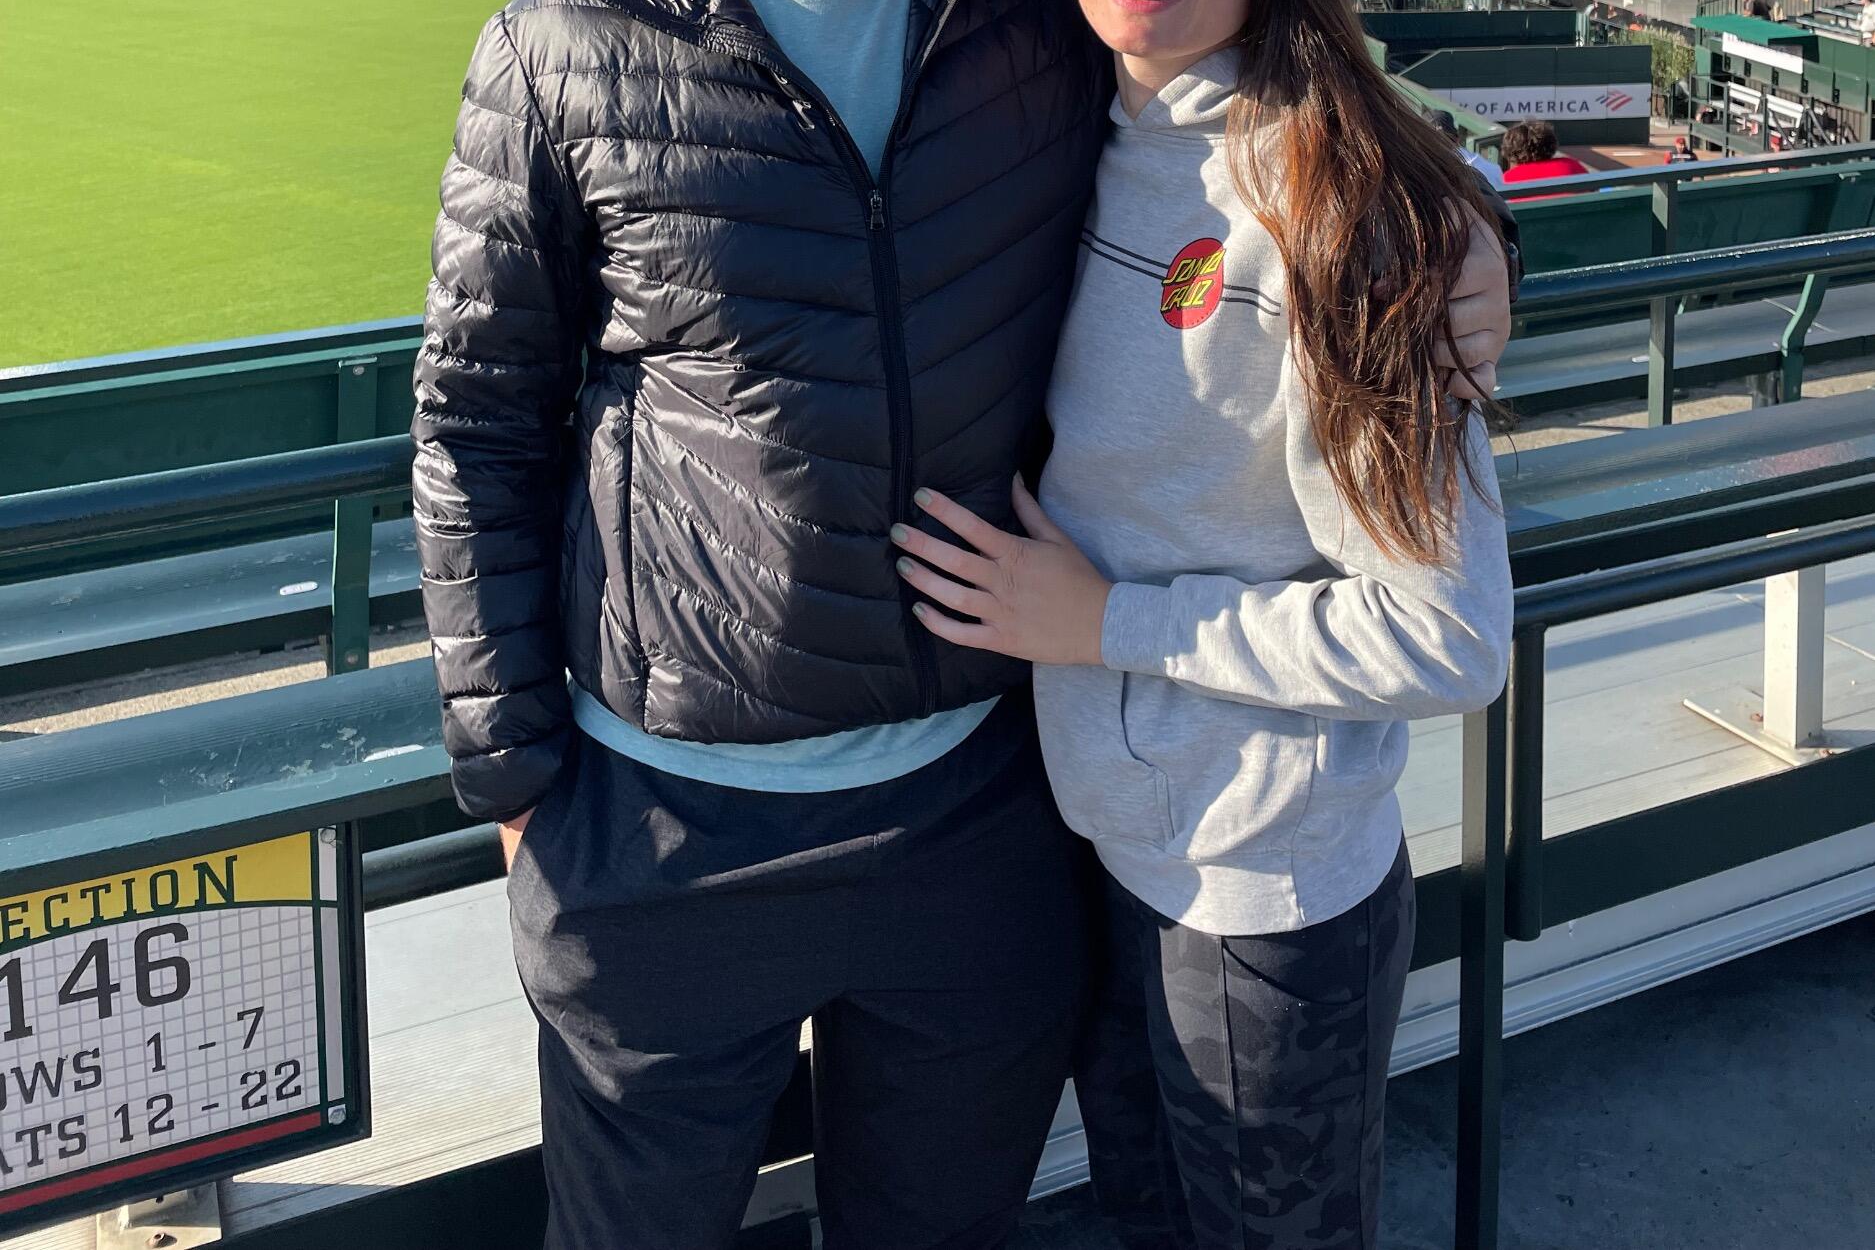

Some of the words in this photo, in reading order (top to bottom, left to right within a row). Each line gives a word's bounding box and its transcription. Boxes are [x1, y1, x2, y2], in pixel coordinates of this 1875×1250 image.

[1475, 102, 1498, 115] OF
[1503, 100, 1590, 114] AMERICA
[0, 854, 238, 947] ECTION
[0, 922, 191, 1042] 146
[147, 1032, 166, 1072] 1
[237, 1006, 264, 1050] 7
[114, 1093, 175, 1143] 12
[240, 1059, 302, 1110] 22
